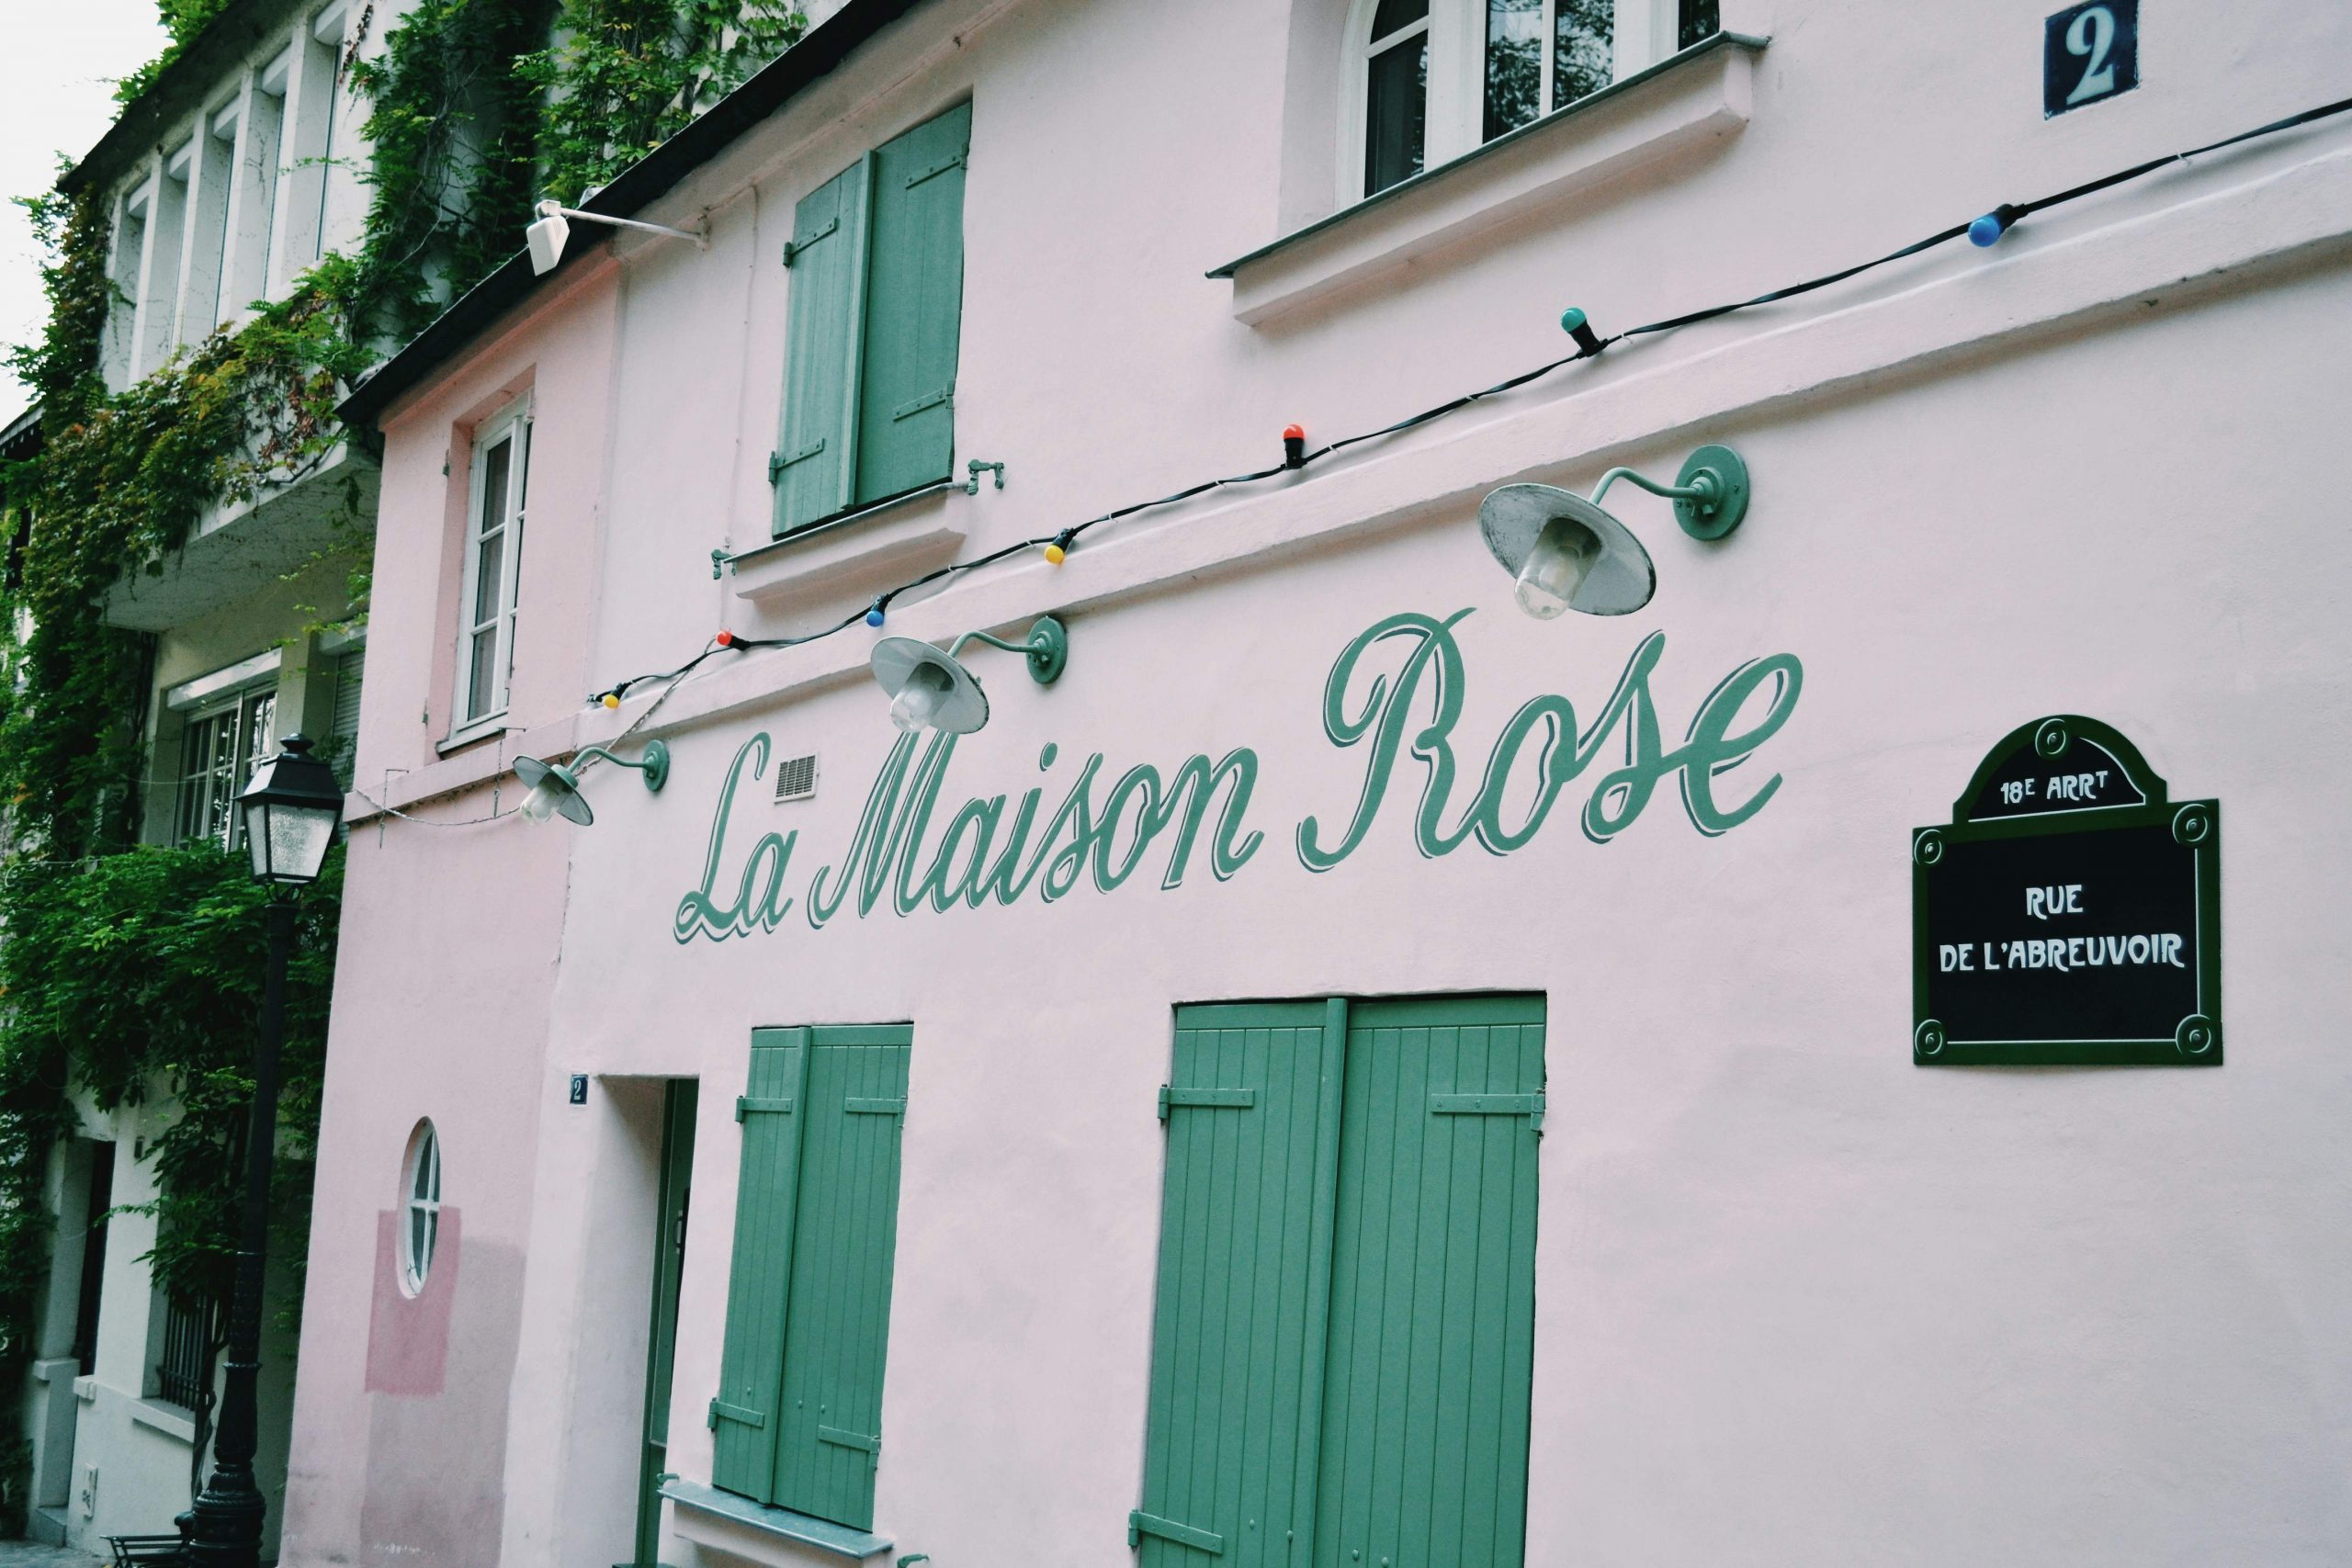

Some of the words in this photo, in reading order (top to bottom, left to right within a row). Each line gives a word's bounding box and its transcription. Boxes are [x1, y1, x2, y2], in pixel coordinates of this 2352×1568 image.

[2065, 6, 2114, 106] 2
[673, 732, 799, 945] La
[807, 731, 1264, 931] Maison
[1295, 607, 1804, 874] Rose
[2000, 778, 2036, 805] 18E
[2026, 884, 2084, 920] RUE
[1939, 942, 1975, 972] DE
[1984, 932, 2185, 973] L'ABREUVOIR
[573, 1079, 582, 1100] 2
